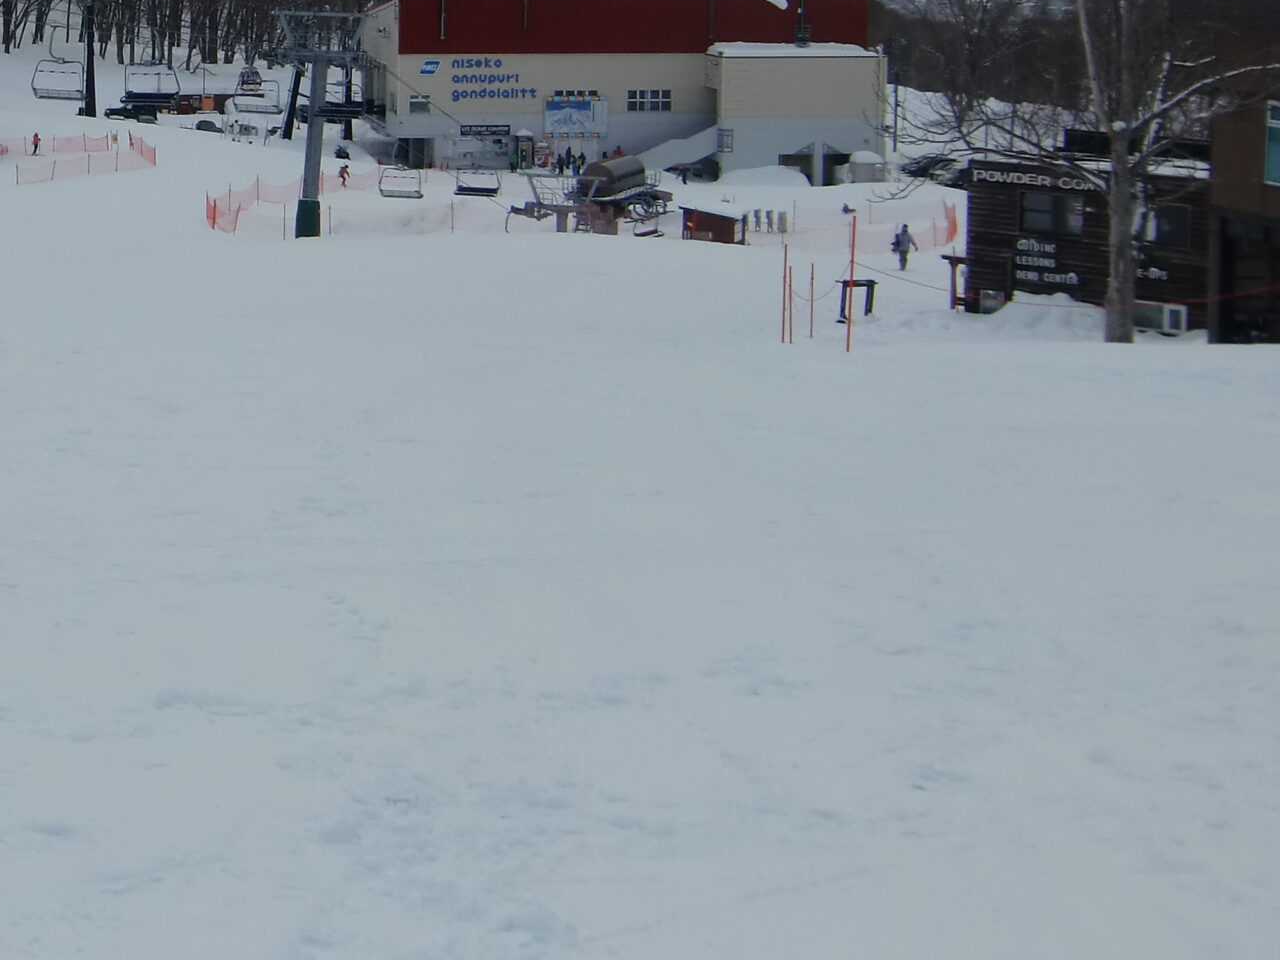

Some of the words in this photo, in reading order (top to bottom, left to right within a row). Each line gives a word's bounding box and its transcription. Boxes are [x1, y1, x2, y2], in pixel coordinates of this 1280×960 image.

[451, 57, 502, 69] niseko
[451, 74, 519, 84] annupuri
[972, 169, 1052, 187] POWDER
[1016, 255, 1056, 268] LESSONS
